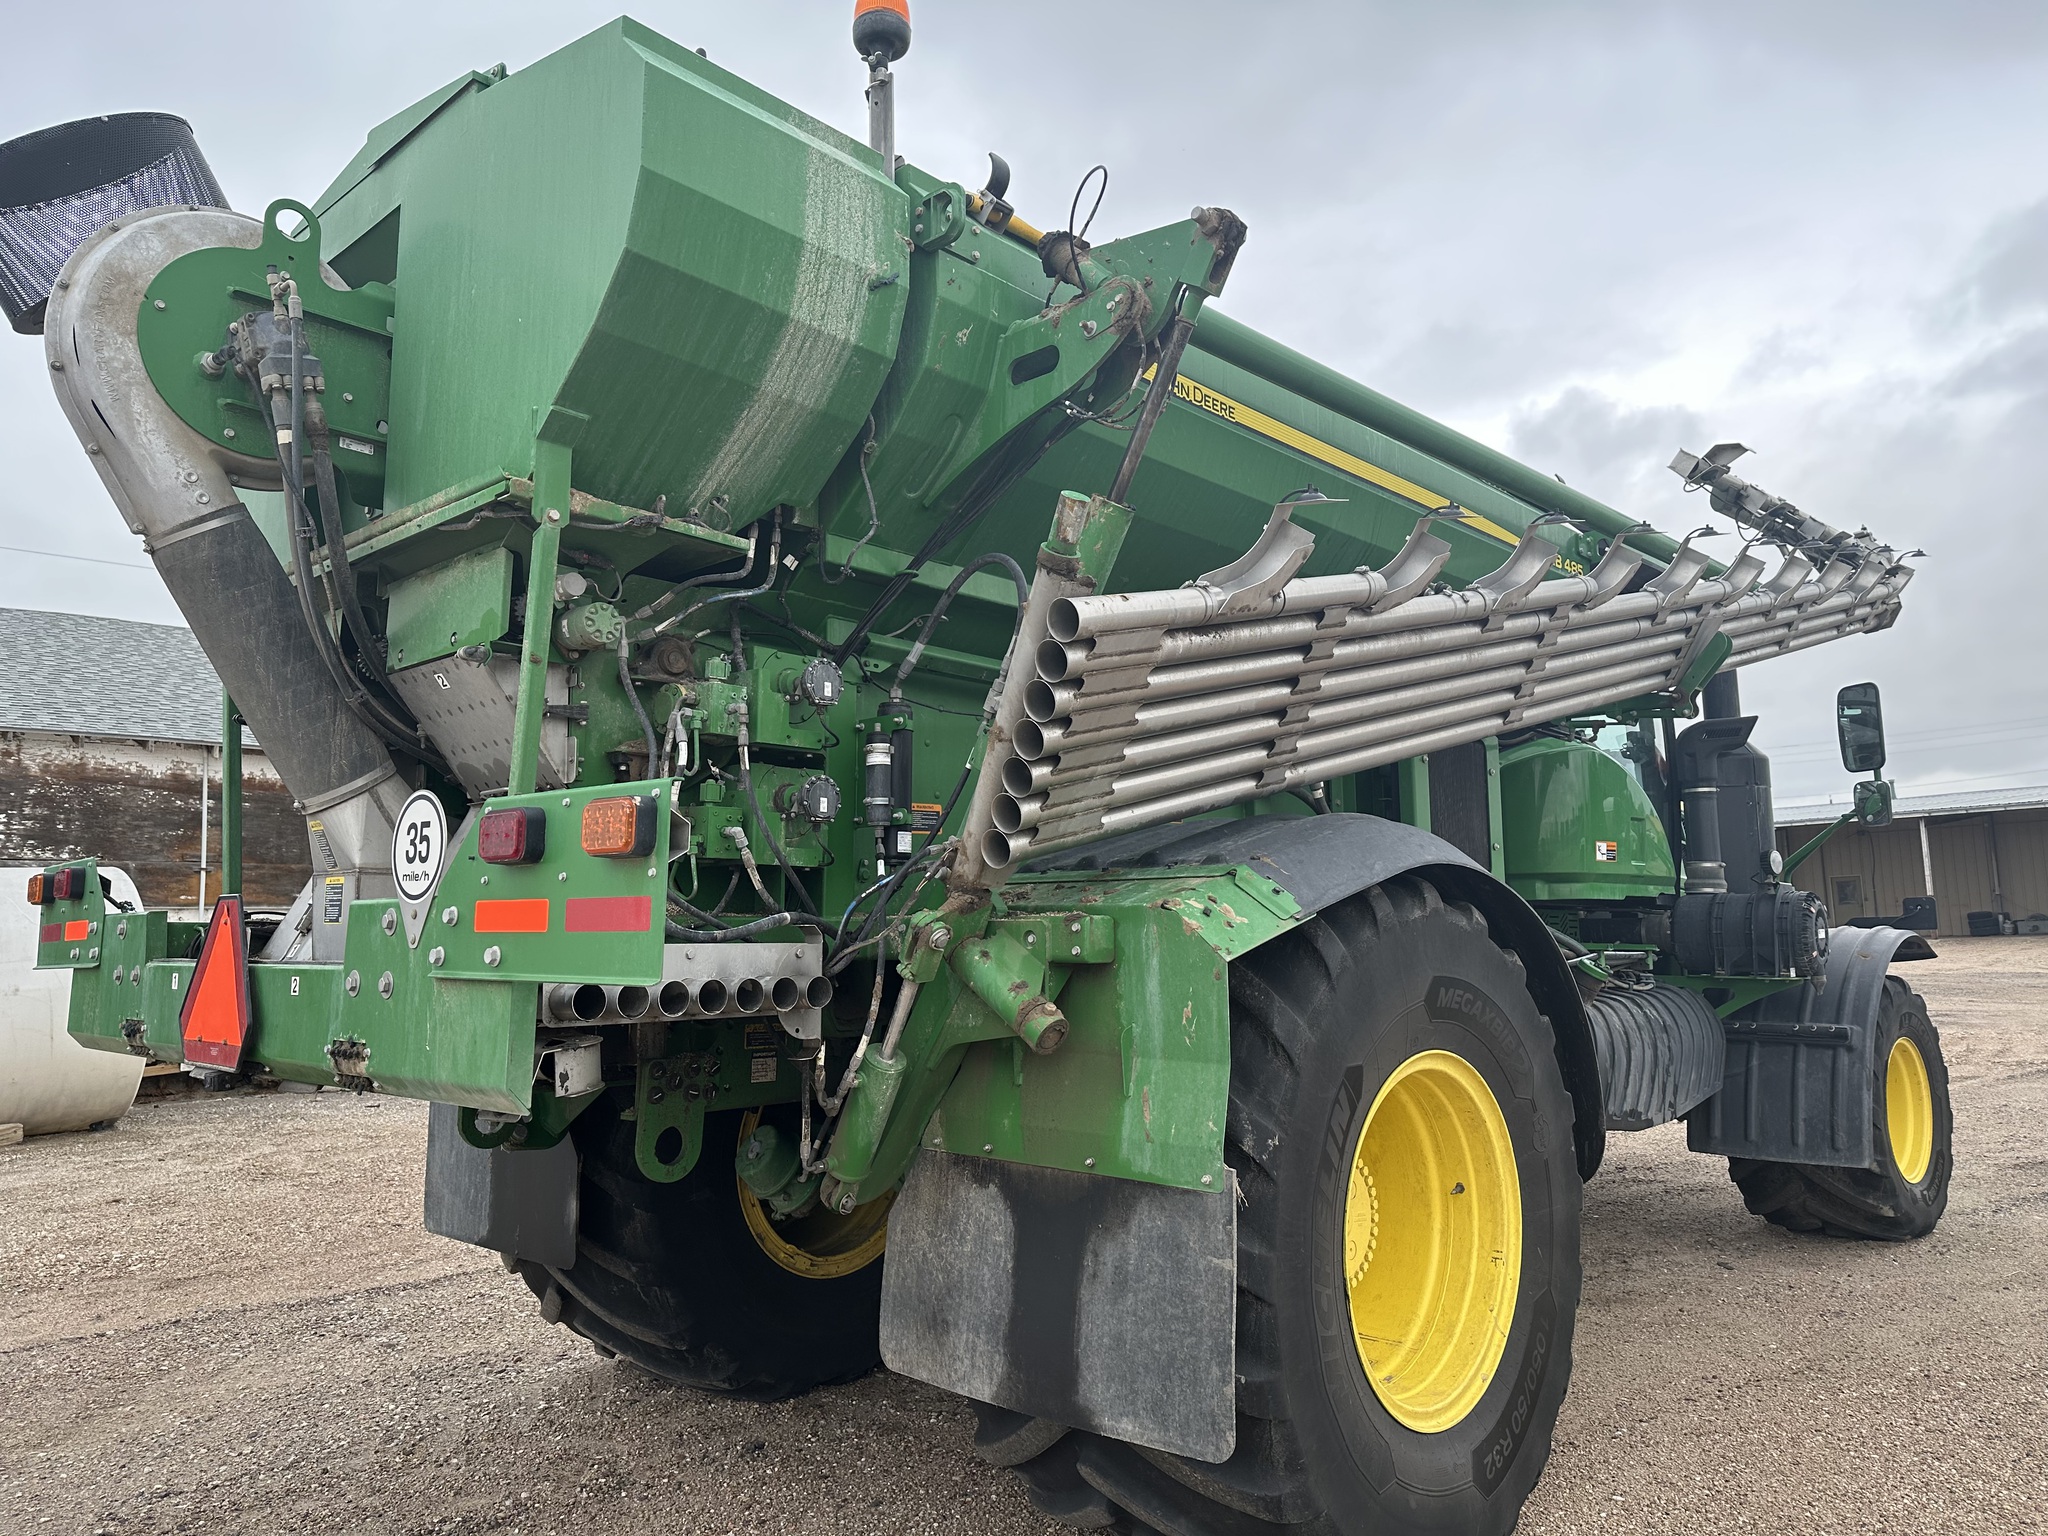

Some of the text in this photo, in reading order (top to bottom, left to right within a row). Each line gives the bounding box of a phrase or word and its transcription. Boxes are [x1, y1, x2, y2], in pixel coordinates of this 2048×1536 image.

[1173, 380, 1236, 420] HN DEERE
[1564, 558, 1584, 577] 485
[436, 675, 448, 688] 2
[405, 820, 432, 865] 35
[402, 870, 430, 882] mile/h
[292, 977, 298, 994] 2
[1483, 1316, 1549, 1480] 1050/50 R32
